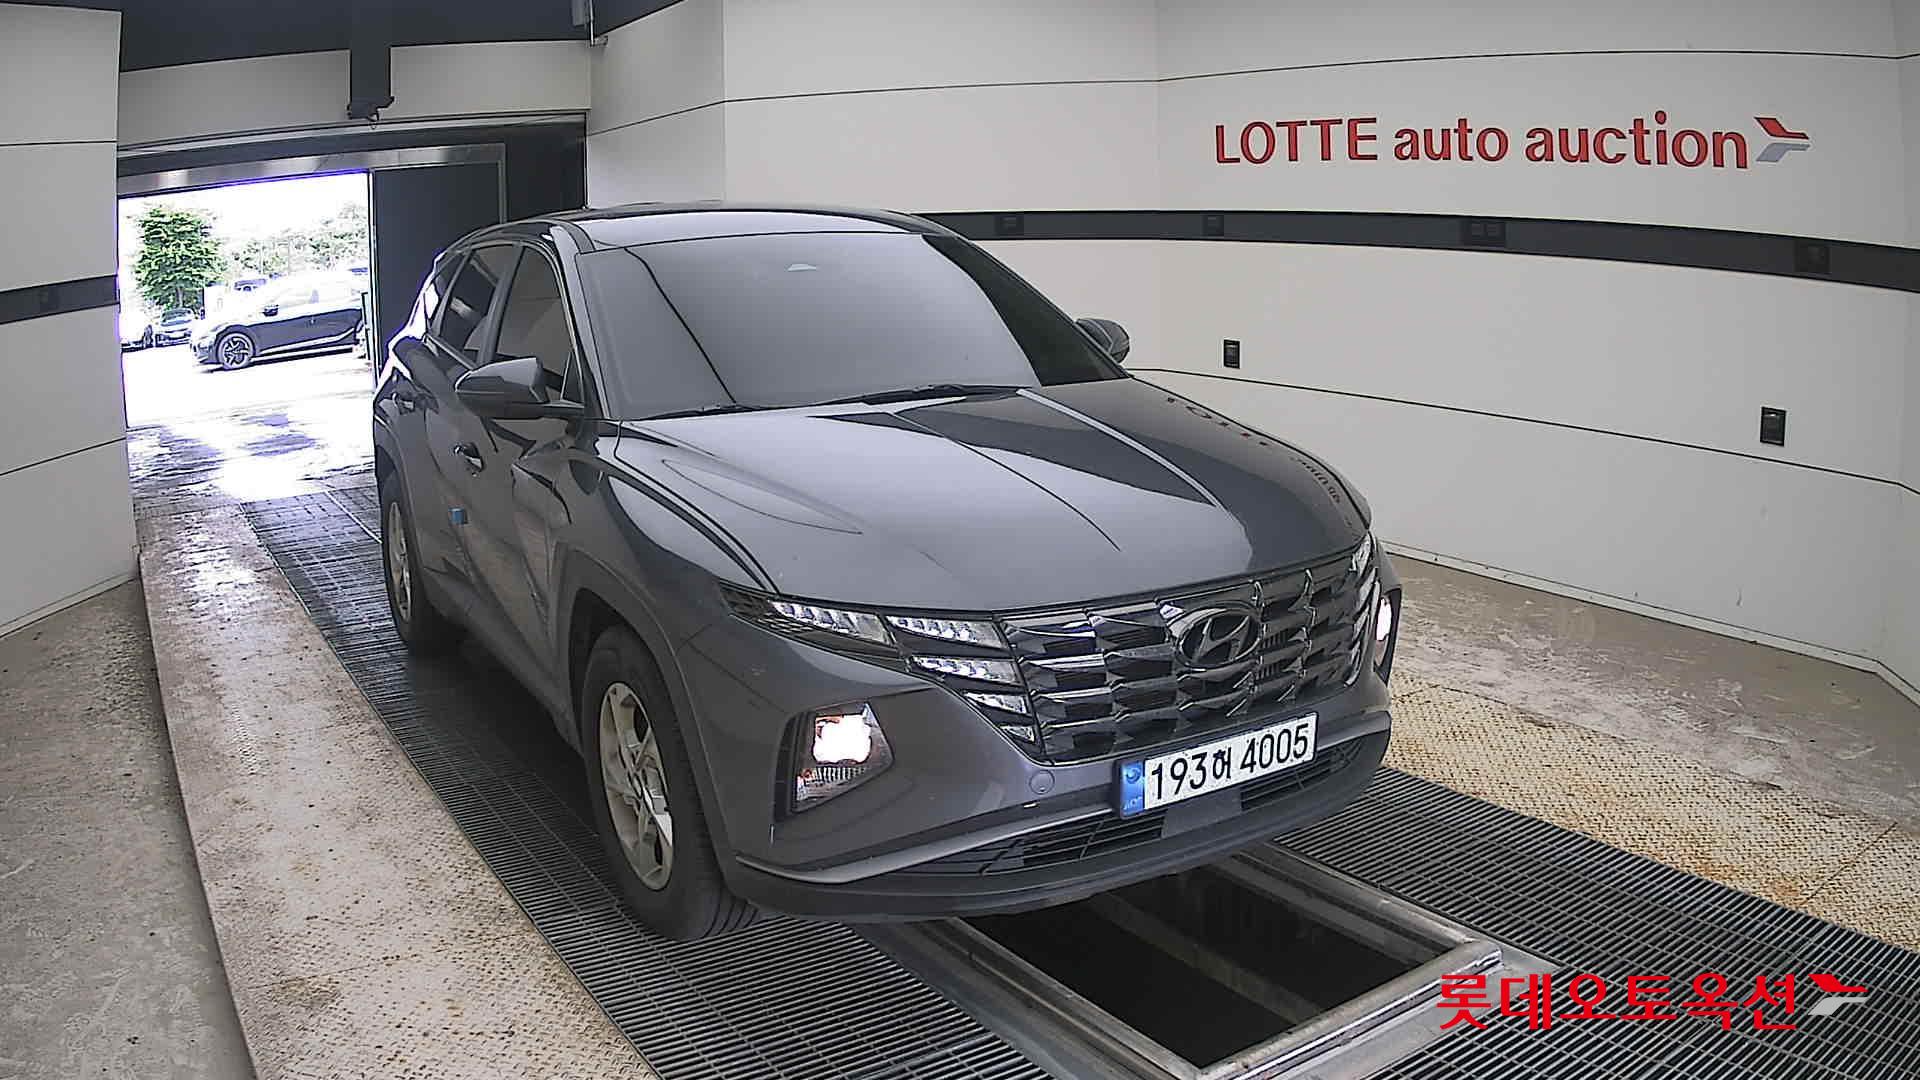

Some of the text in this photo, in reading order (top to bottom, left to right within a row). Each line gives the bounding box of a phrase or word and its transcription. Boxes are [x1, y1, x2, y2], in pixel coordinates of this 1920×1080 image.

[1214, 110, 1750, 169] LOTTE auto auction
[1151, 723, 1309, 800] 193허 4005
